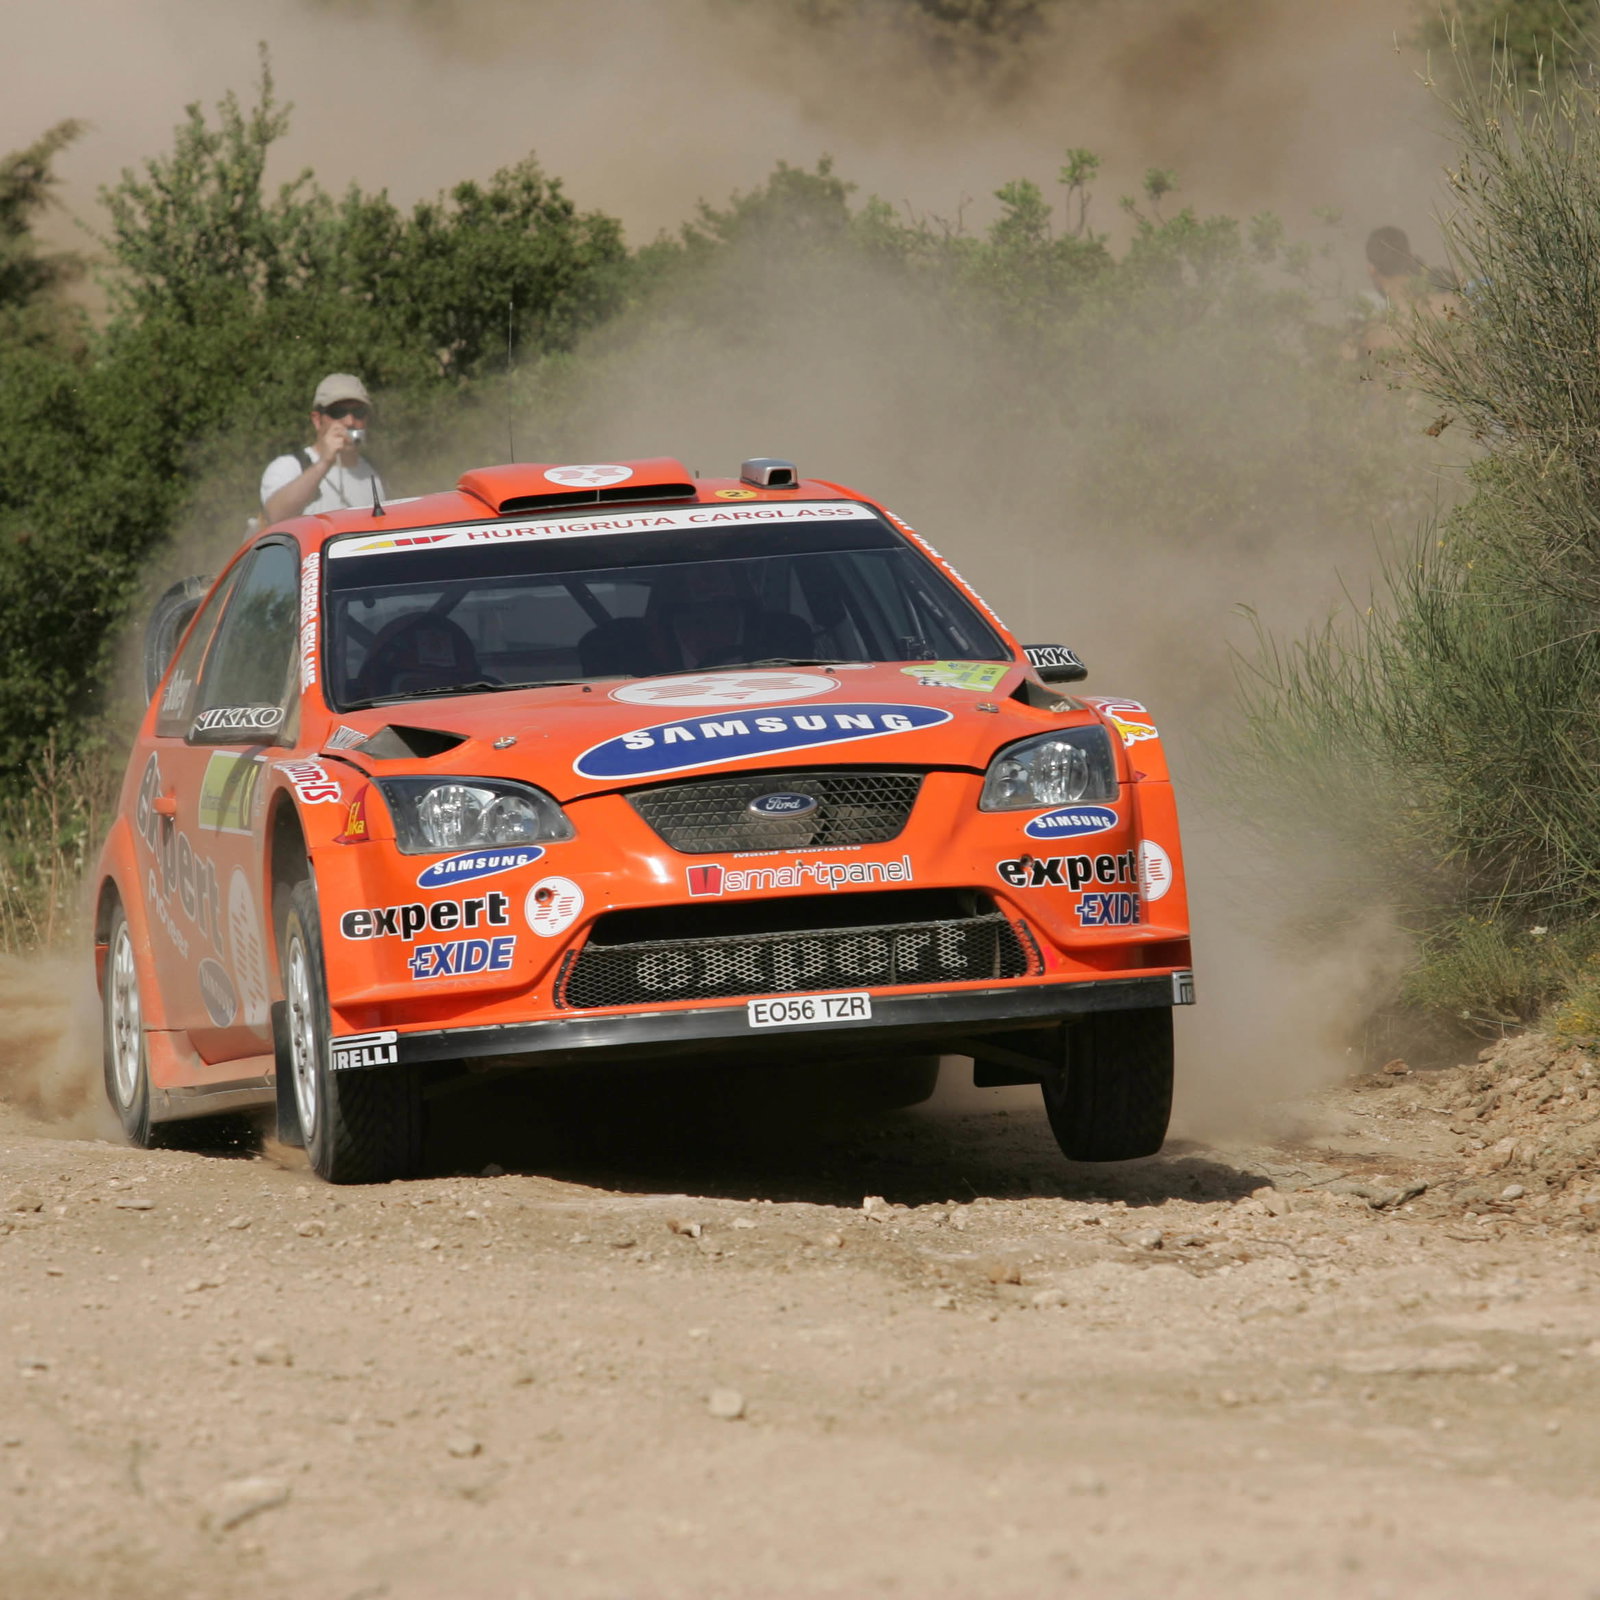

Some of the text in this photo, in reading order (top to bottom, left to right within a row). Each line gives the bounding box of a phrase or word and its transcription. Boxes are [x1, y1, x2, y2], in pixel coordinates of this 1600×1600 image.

[467, 507, 854, 541] HURTIGRUTA CARGLASS
[622, 713, 915, 750] SAMSUNG
[765, 796, 801, 810] Ford
[1035, 815, 1112, 829] SAMSUNG
[433, 854, 529, 875] SAMSUNG
[733, 846, 861, 858] Maud Charlotte
[724, 854, 914, 891] smartpanel
[996, 849, 1138, 892] expert
[340, 891, 509, 942] expert
[1074, 892, 1141, 927] EXIDE
[407, 935, 517, 980] EXIDE
[636, 924, 968, 991] expert
[754, 996, 866, 1023] EO56 TZR
[329, 1030, 399, 1071] PIRELLI
